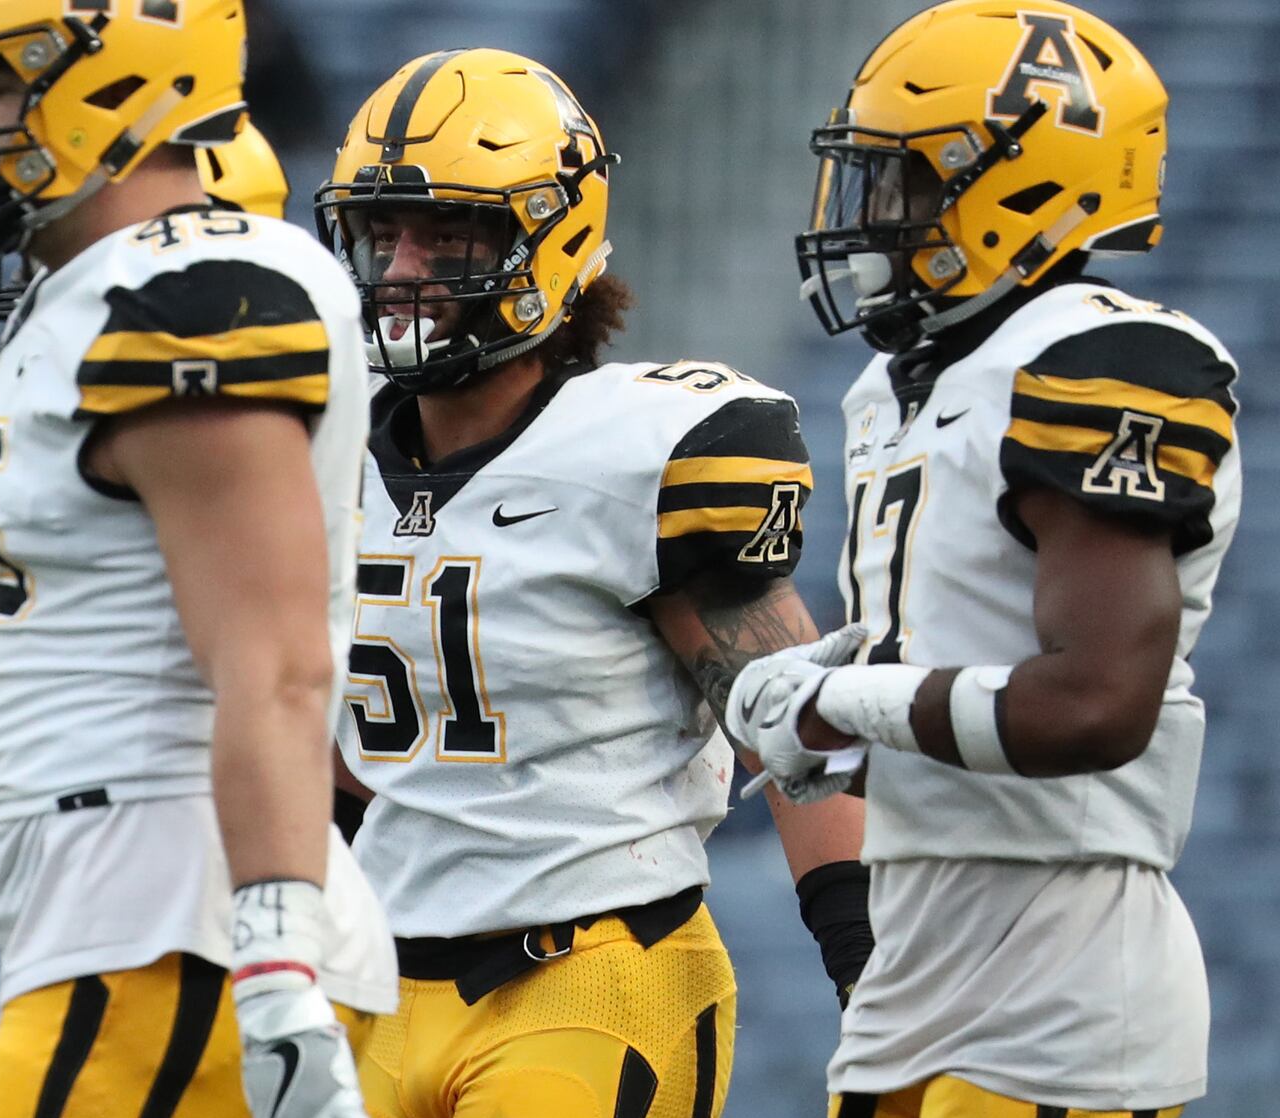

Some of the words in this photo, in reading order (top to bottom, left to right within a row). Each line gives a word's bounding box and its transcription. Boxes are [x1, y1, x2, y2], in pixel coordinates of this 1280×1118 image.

[983, 9, 1107, 138] A
[128, 205, 259, 256] 45
[1081, 410, 1165, 502] A
[393, 491, 434, 536] A
[737, 483, 800, 562] A
[844, 454, 928, 666] 17
[343, 554, 507, 763] 51
